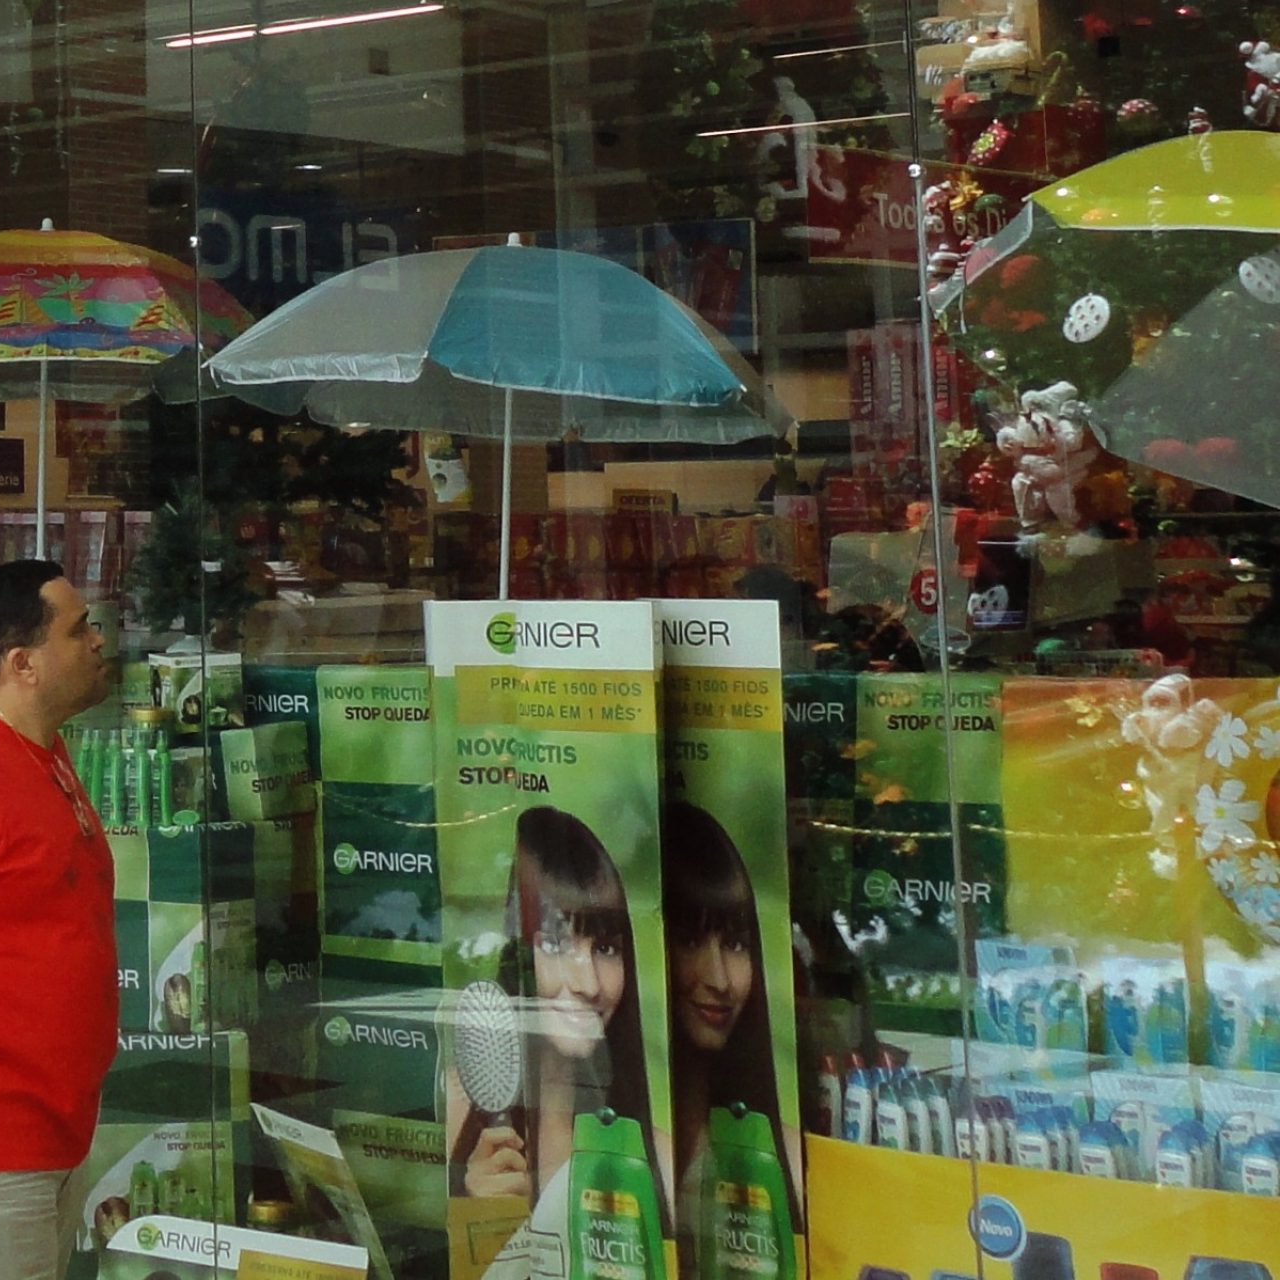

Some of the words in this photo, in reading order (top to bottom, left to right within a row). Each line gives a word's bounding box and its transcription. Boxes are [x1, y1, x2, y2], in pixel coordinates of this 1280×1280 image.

[323, 685, 365, 701] NOVO
[563, 682, 597, 696] 1500
[603, 682, 643, 697] FIOS
[732, 680, 769, 695] FIOS
[344, 706, 381, 721] STOP
[383, 707, 431, 722] QUEDA
[559, 704, 581, 719] EM
[887, 714, 930, 731] STOP
[333, 850, 433, 874] GARNIER
[863, 878, 992, 904] GARNIER
[324, 1021, 429, 1051] GARNIER
[980, 1218, 1013, 1237] Novo
[136, 1225, 232, 1259] GARNIER
